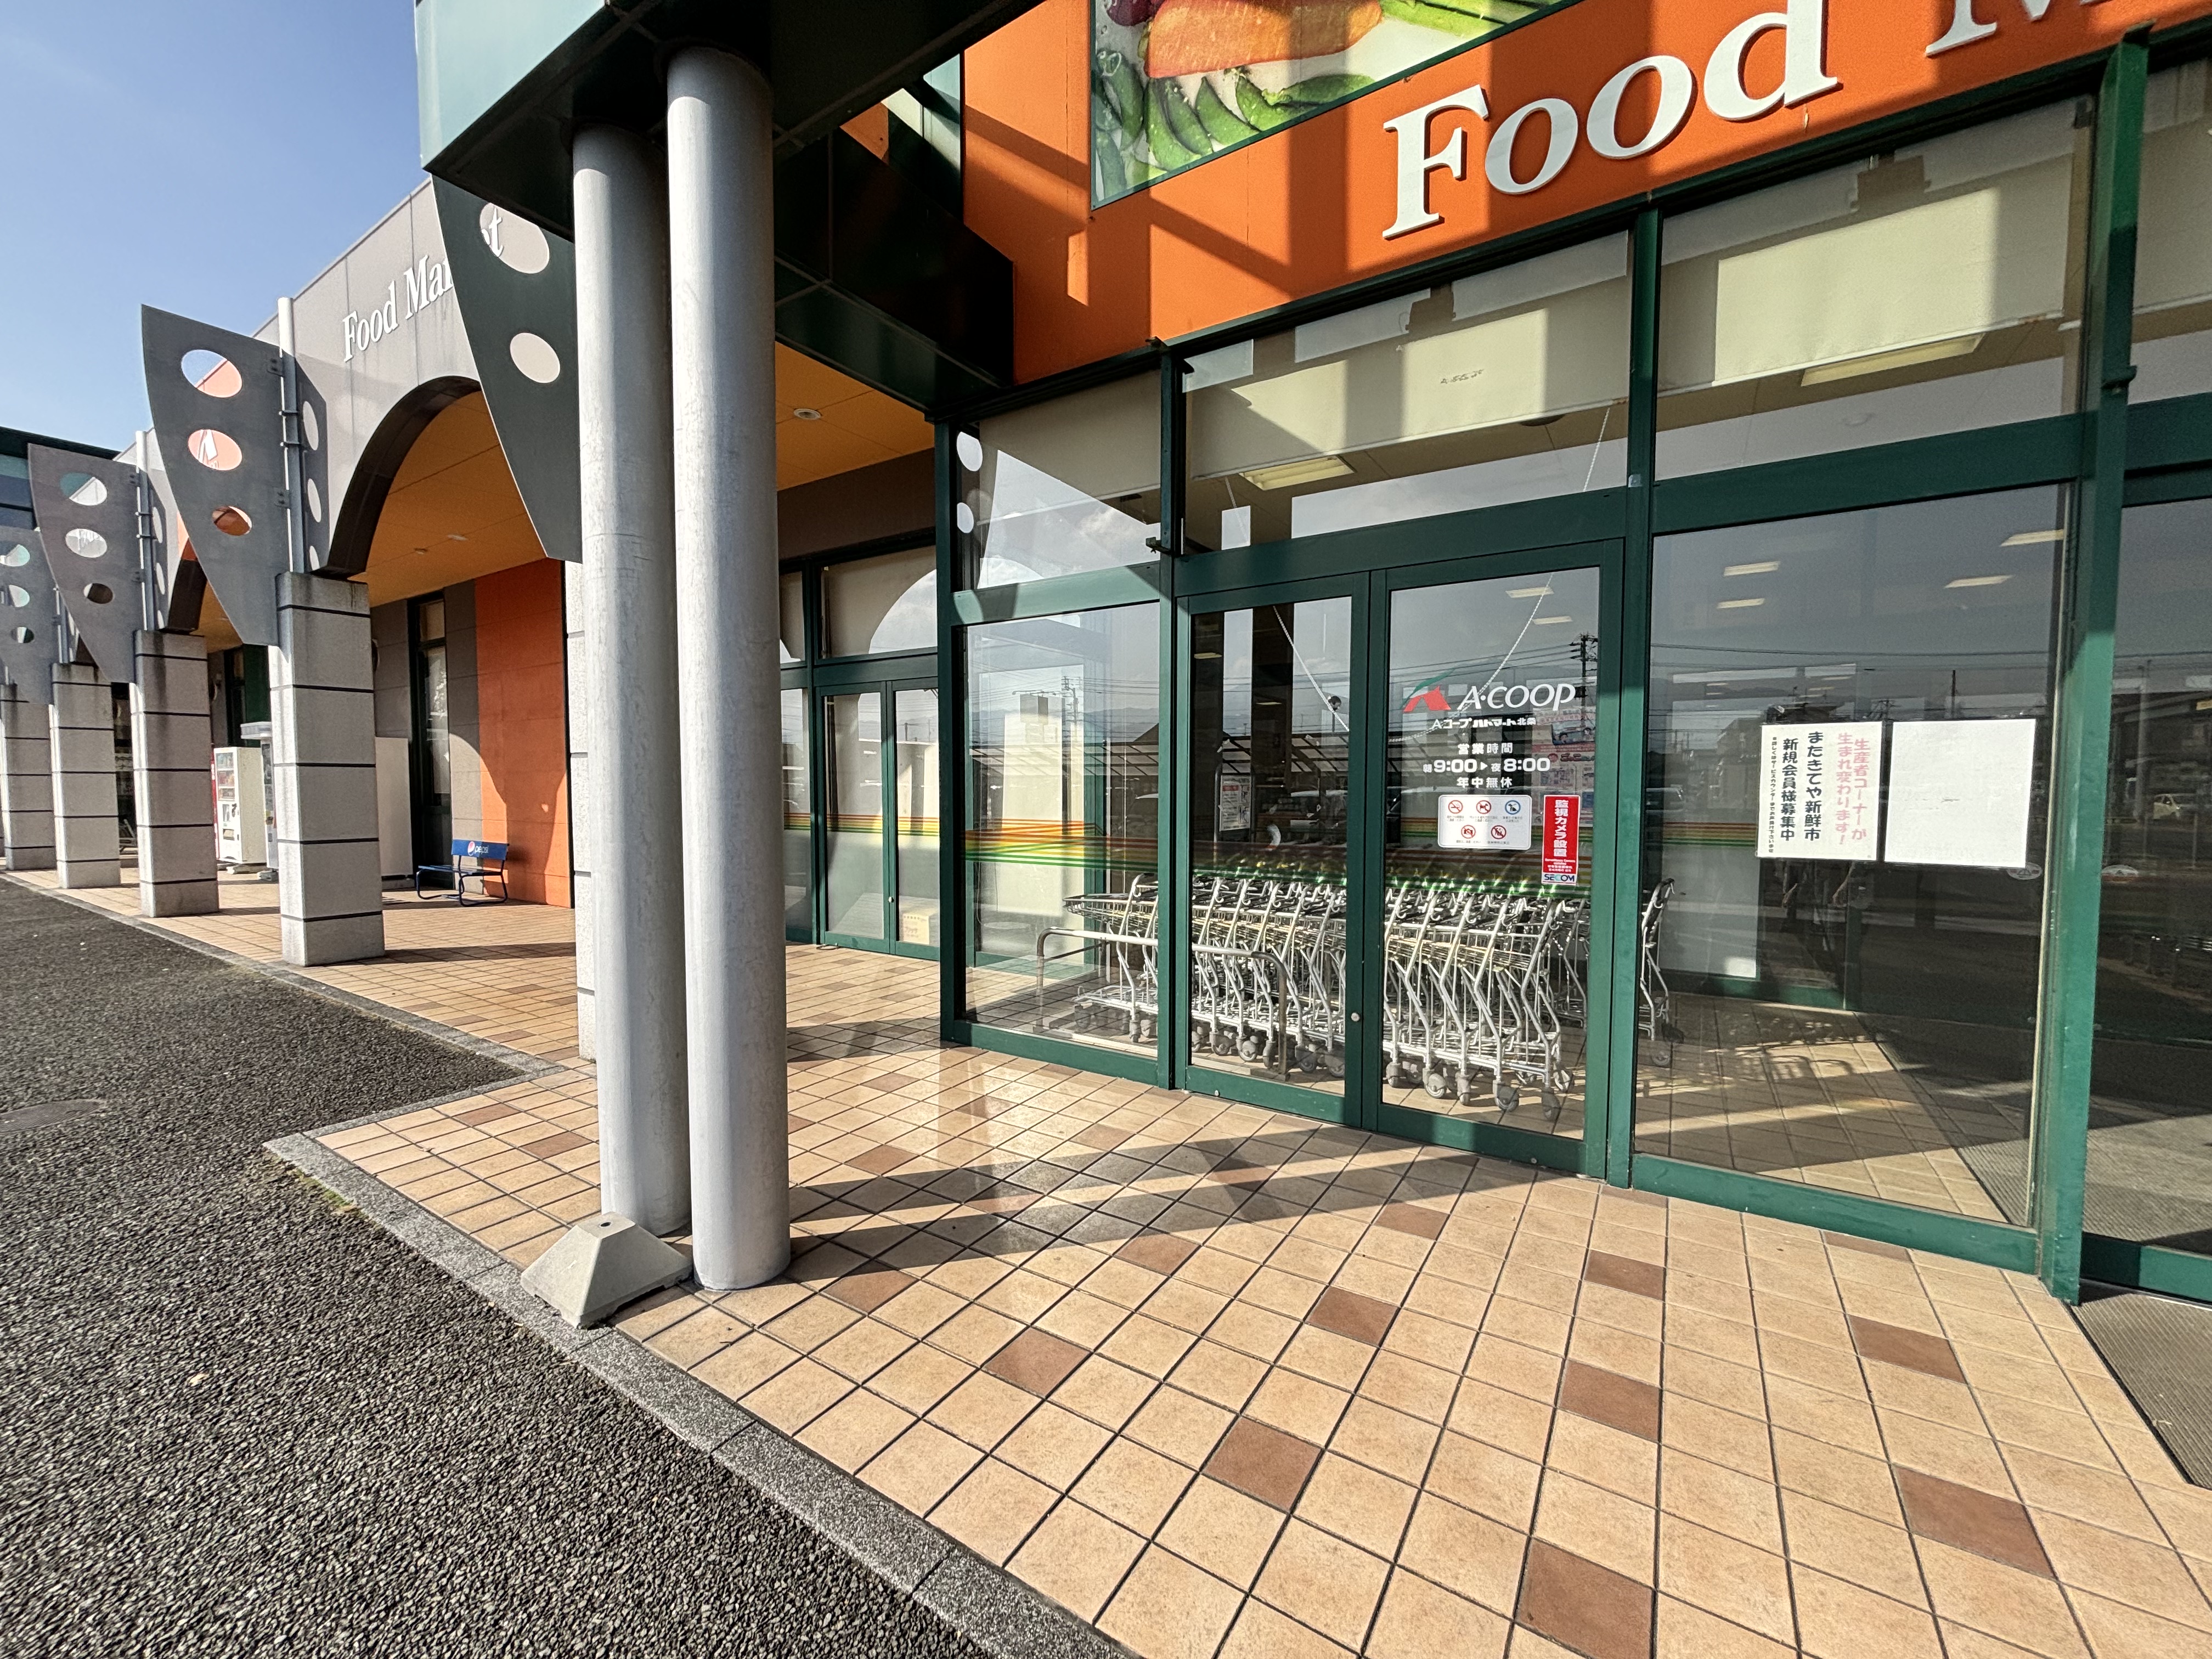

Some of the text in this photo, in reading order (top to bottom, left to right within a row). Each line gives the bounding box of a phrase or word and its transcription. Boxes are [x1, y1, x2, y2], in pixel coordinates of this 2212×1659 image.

[1382, 0, 1838, 240] Food
[342, 280, 399, 362] Food
[1457, 777, 1513, 788] 年中無休
[1458, 743, 1513, 755] 営業時間
[1780, 738, 1799, 841] 新規会員様募集中
[1804, 731, 1824, 841] またきてや新鮮市
[1852, 738, 1870, 840] 生産者コーナーが
[475, 845, 489, 855] pepsi
[1544, 874, 1575, 882] SECOM
